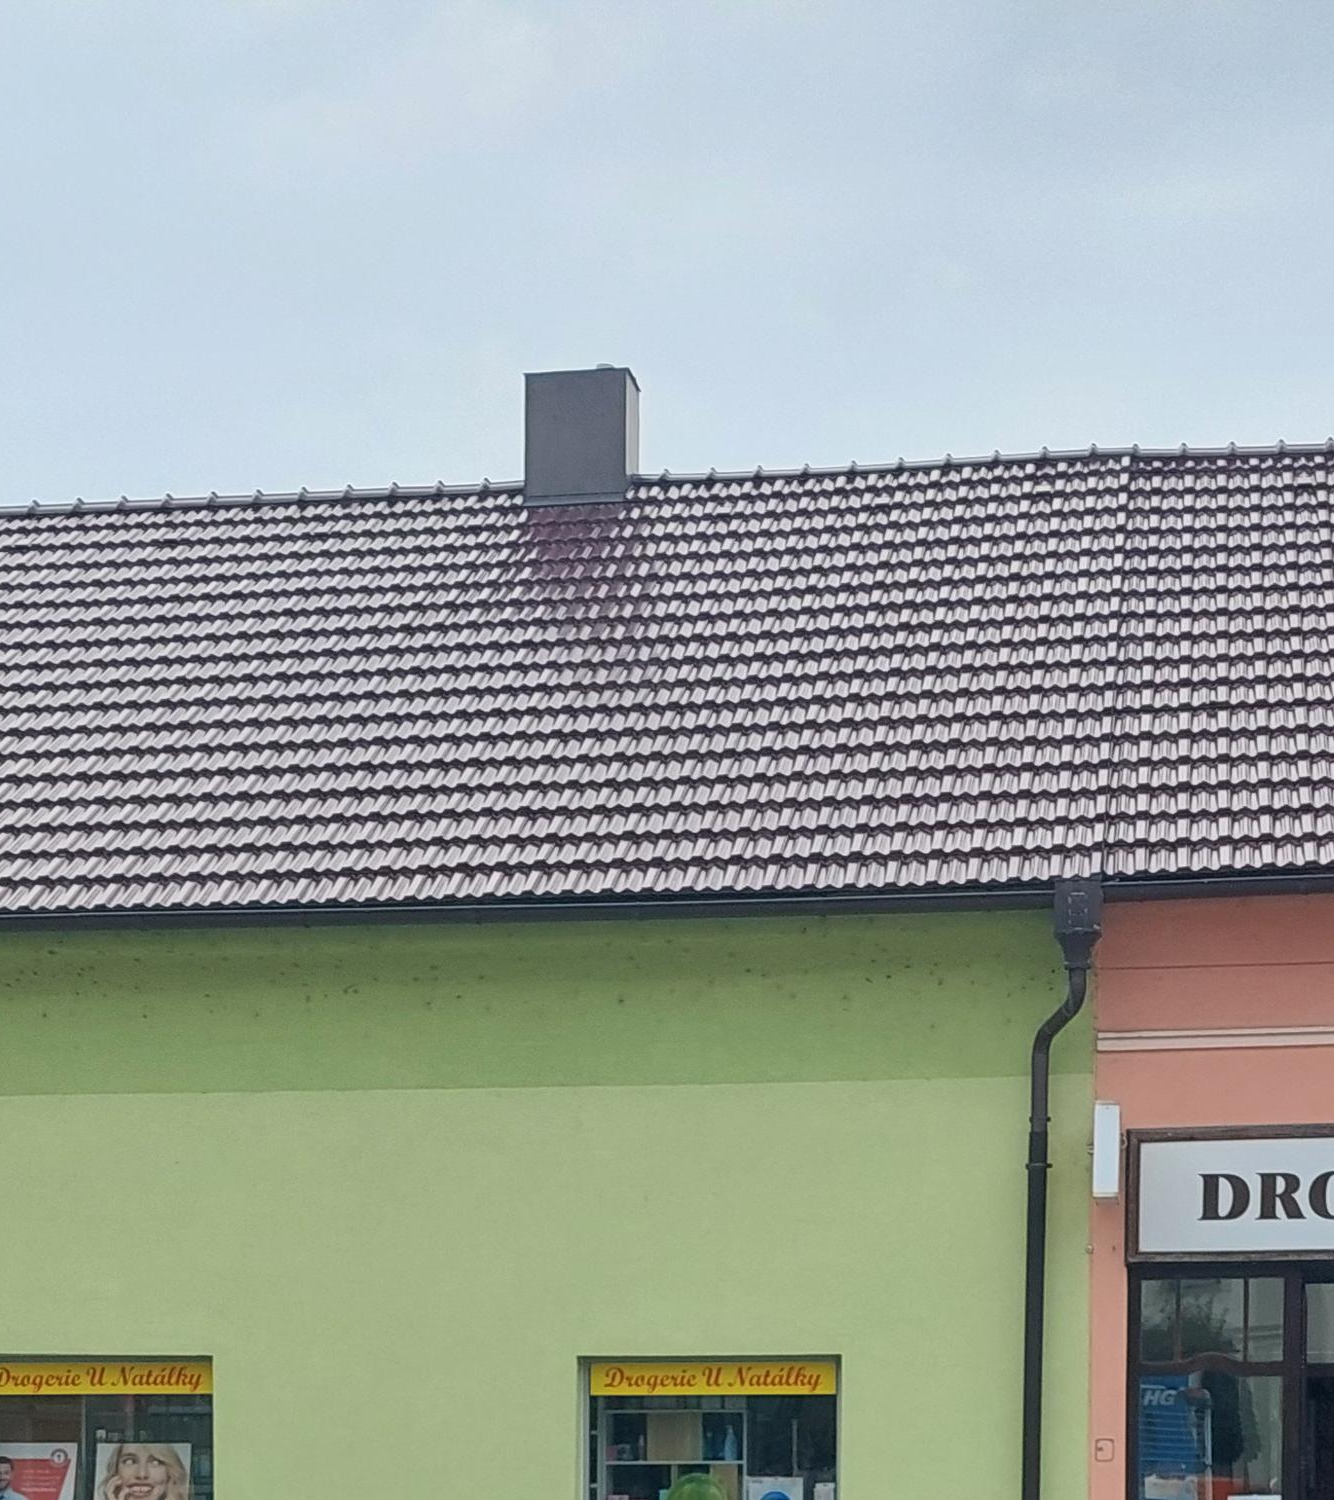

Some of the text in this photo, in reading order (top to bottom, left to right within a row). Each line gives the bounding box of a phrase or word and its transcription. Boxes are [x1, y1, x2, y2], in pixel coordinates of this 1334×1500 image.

[87, 1369, 106, 1386] U
[111, 1366, 203, 1391] Natálky
[604, 1366, 822, 1392] Drogerie U Natálky
[1143, 1390, 1177, 1406] HG
